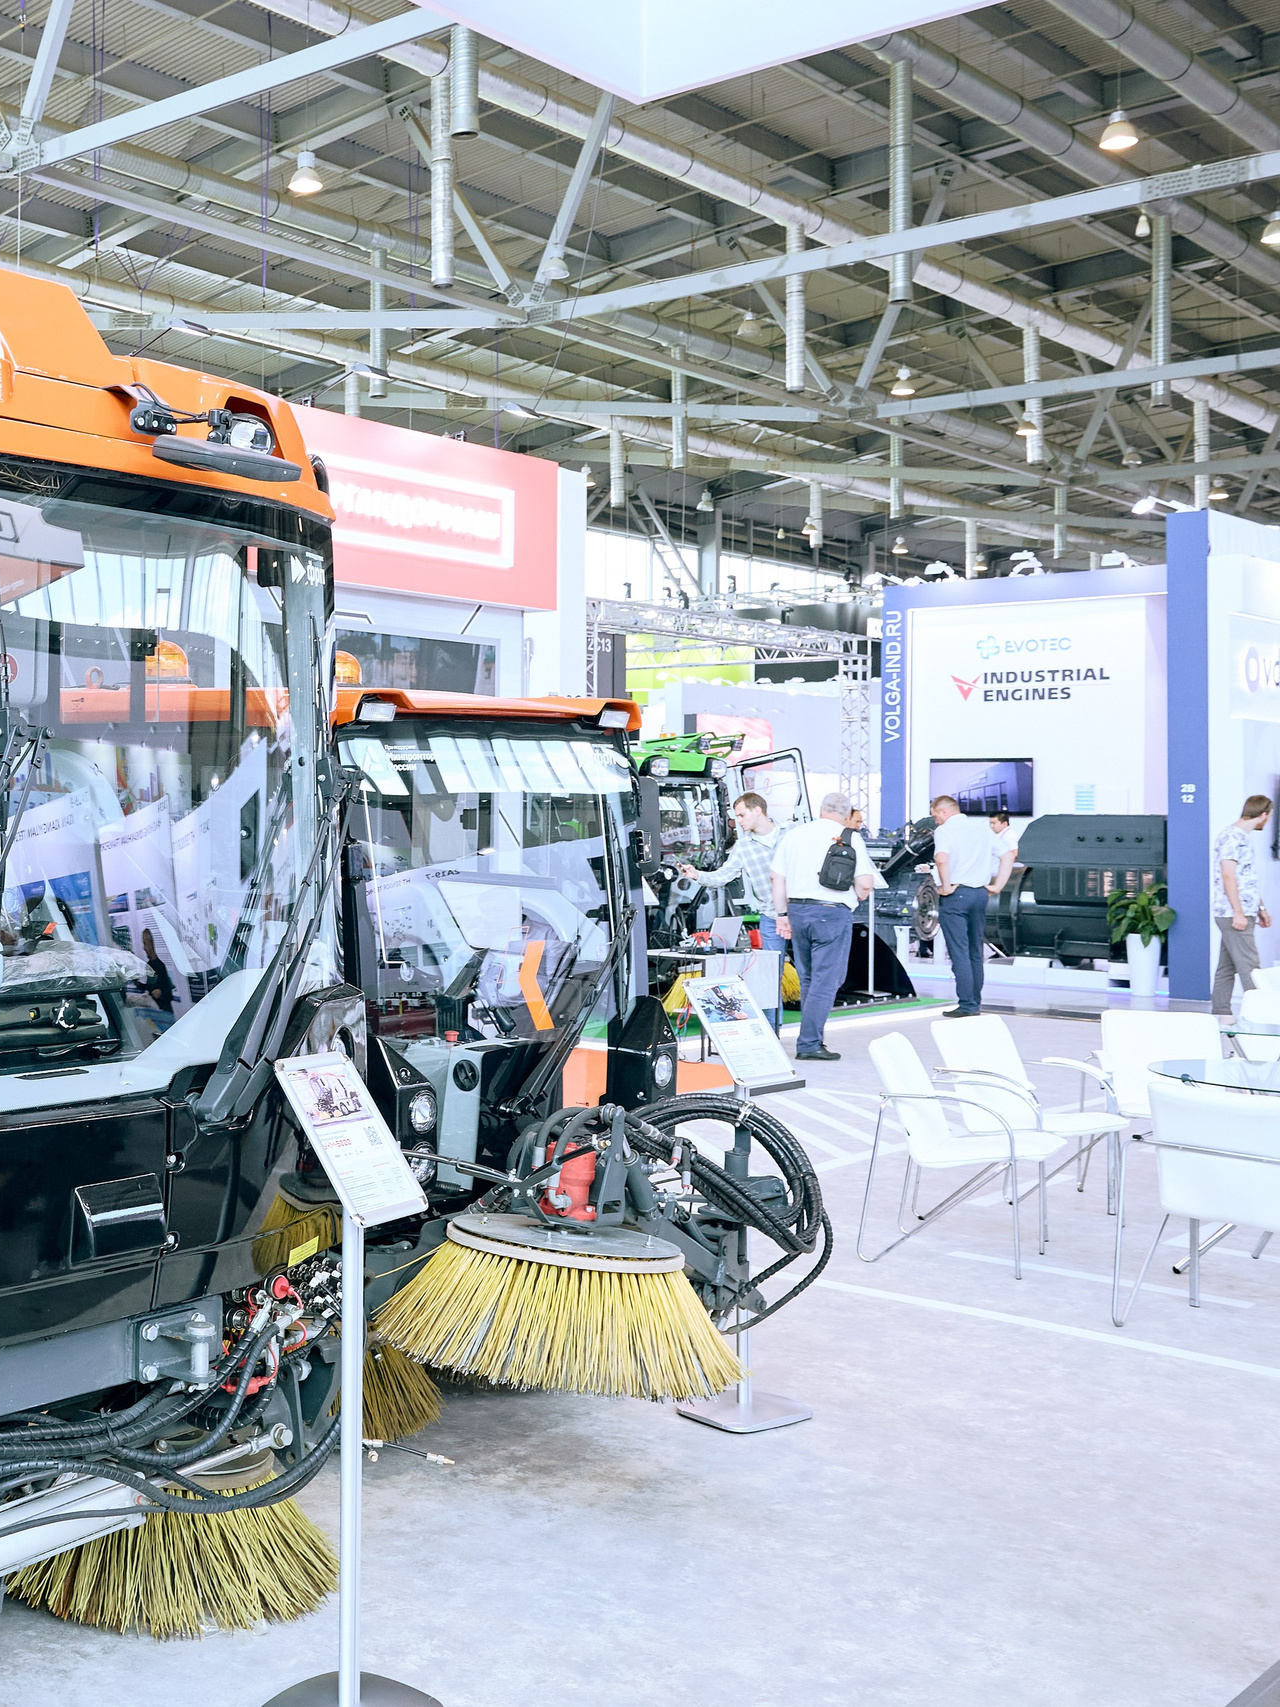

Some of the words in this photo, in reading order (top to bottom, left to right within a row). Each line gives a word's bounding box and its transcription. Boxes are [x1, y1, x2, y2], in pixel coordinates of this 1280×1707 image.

[1005, 637, 1072, 653] EVOTEC
[884, 610, 902, 743] VOLGA-IND.RU
[983, 667, 1111, 685] INDUSTRIAL
[983, 686, 1072, 702] ENGINES
[1180, 794, 1195, 803] 12
